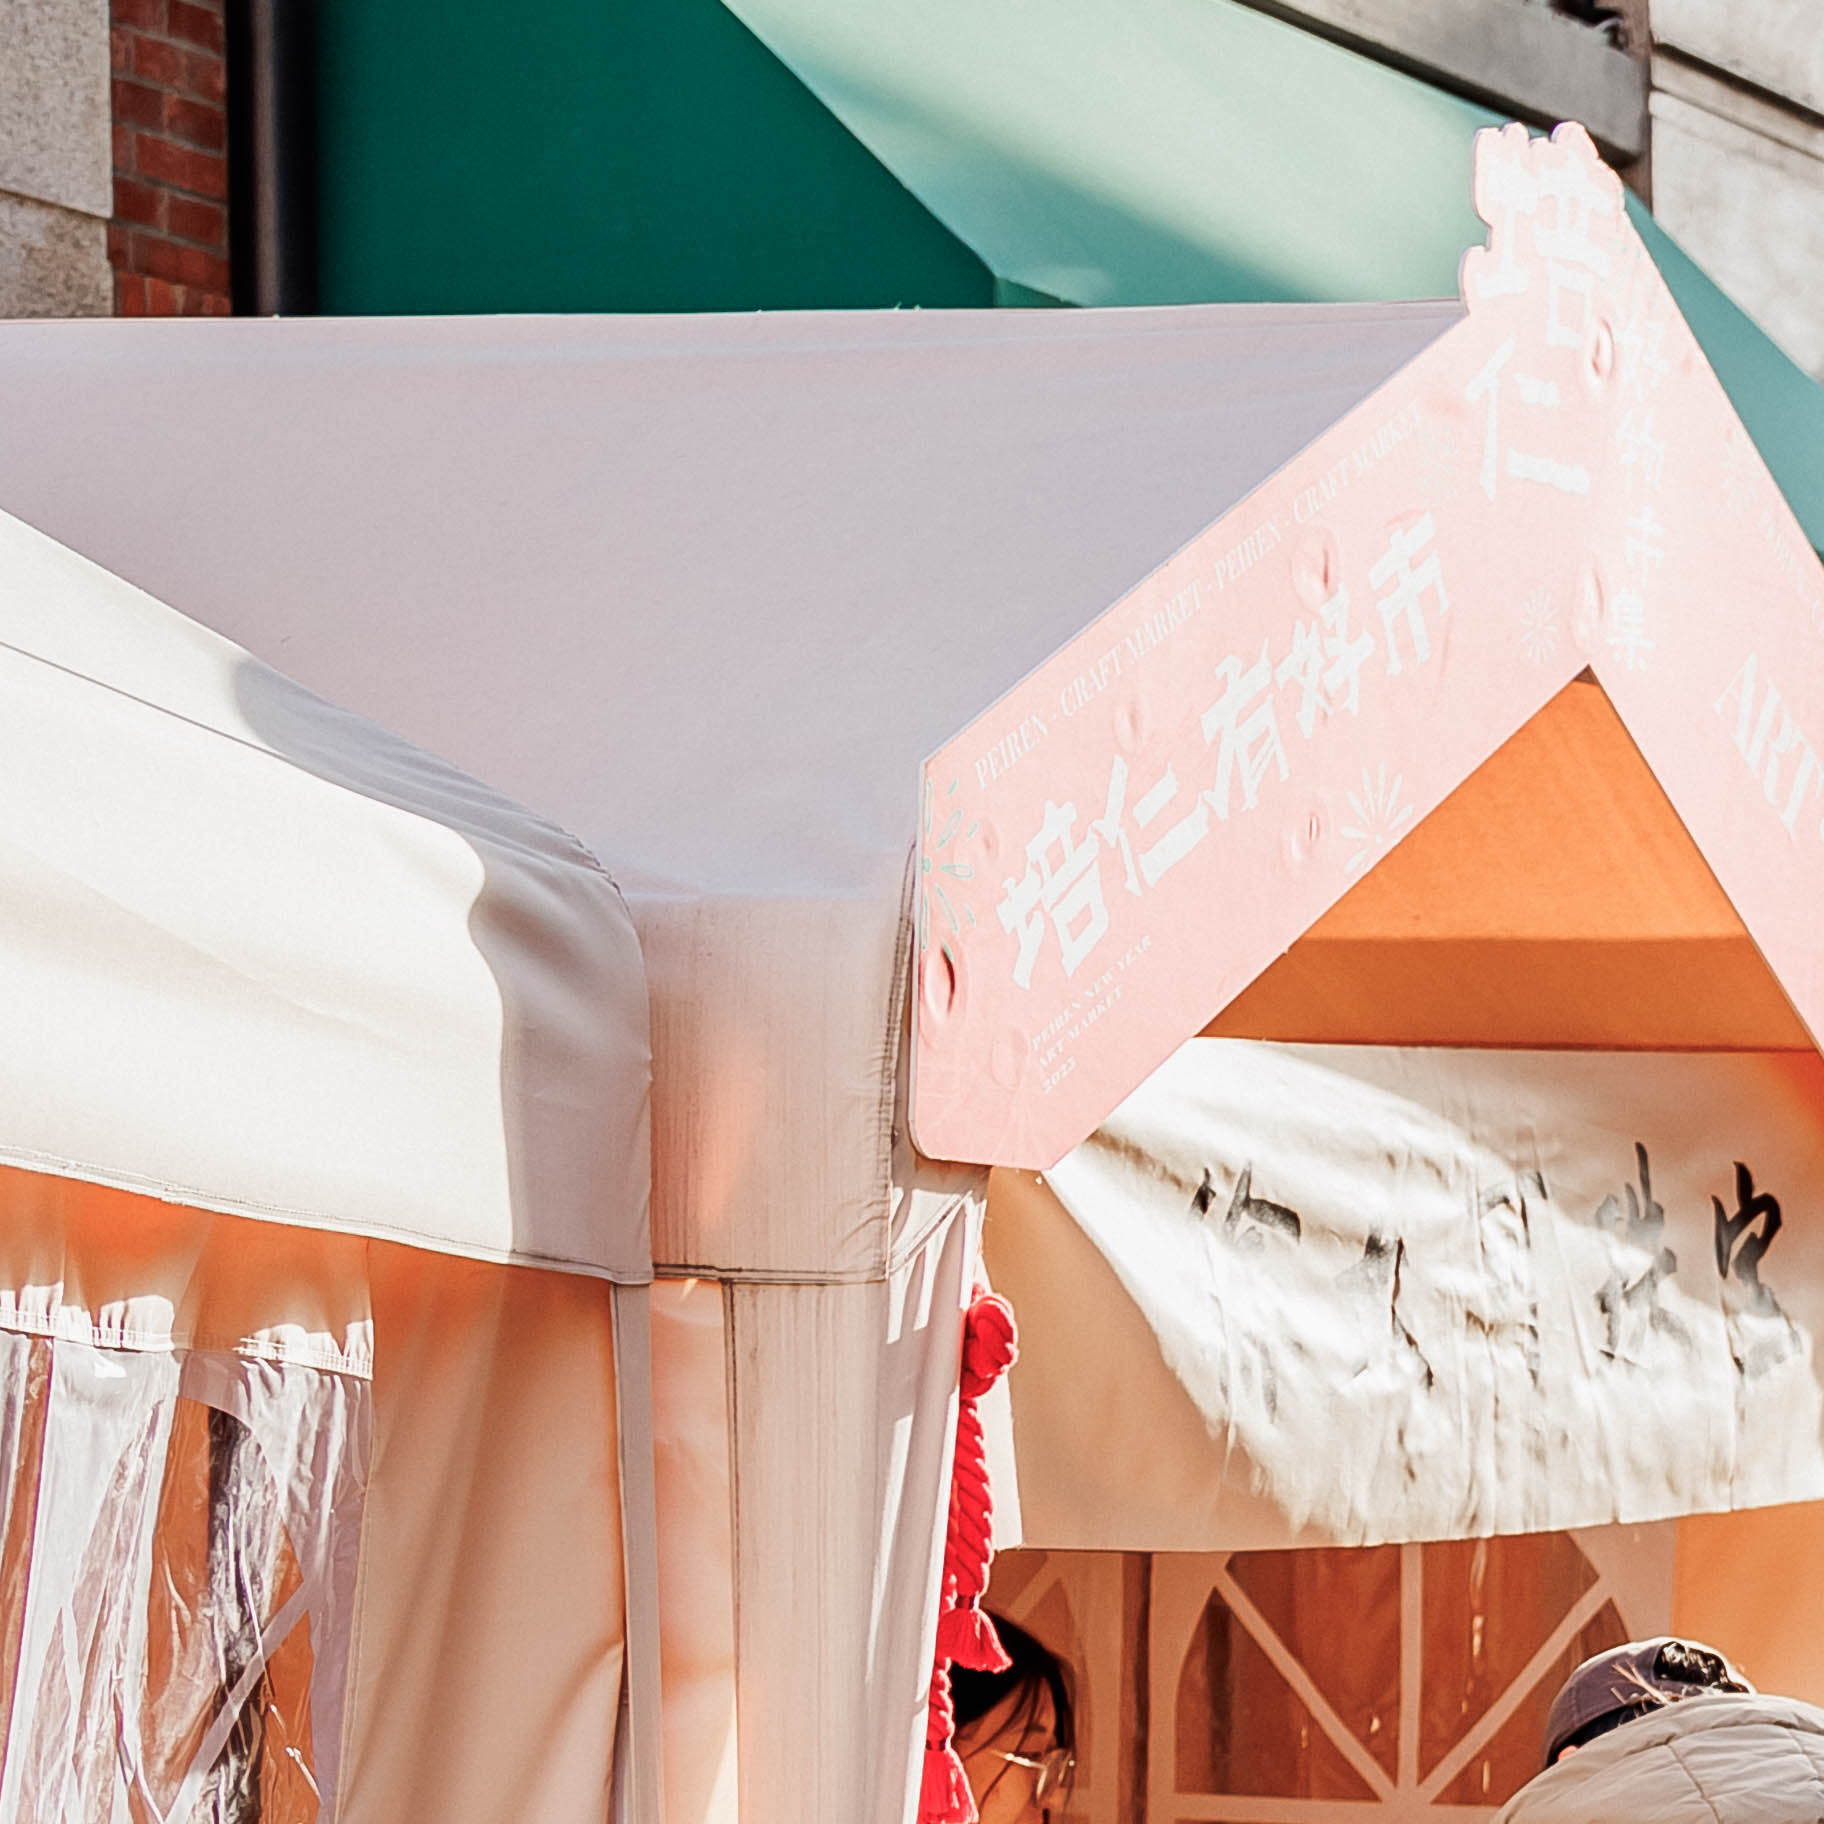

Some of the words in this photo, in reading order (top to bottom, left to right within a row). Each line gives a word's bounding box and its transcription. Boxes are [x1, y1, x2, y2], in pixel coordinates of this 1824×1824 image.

[974, 713, 1049, 790] PEIREN
[1059, 643, 1122, 719] CRAFT
[1120, 580, 1203, 667] MARKET
[1215, 520, 1284, 593] PEIREN
[1293, 458, 1352, 525] CRAFT
